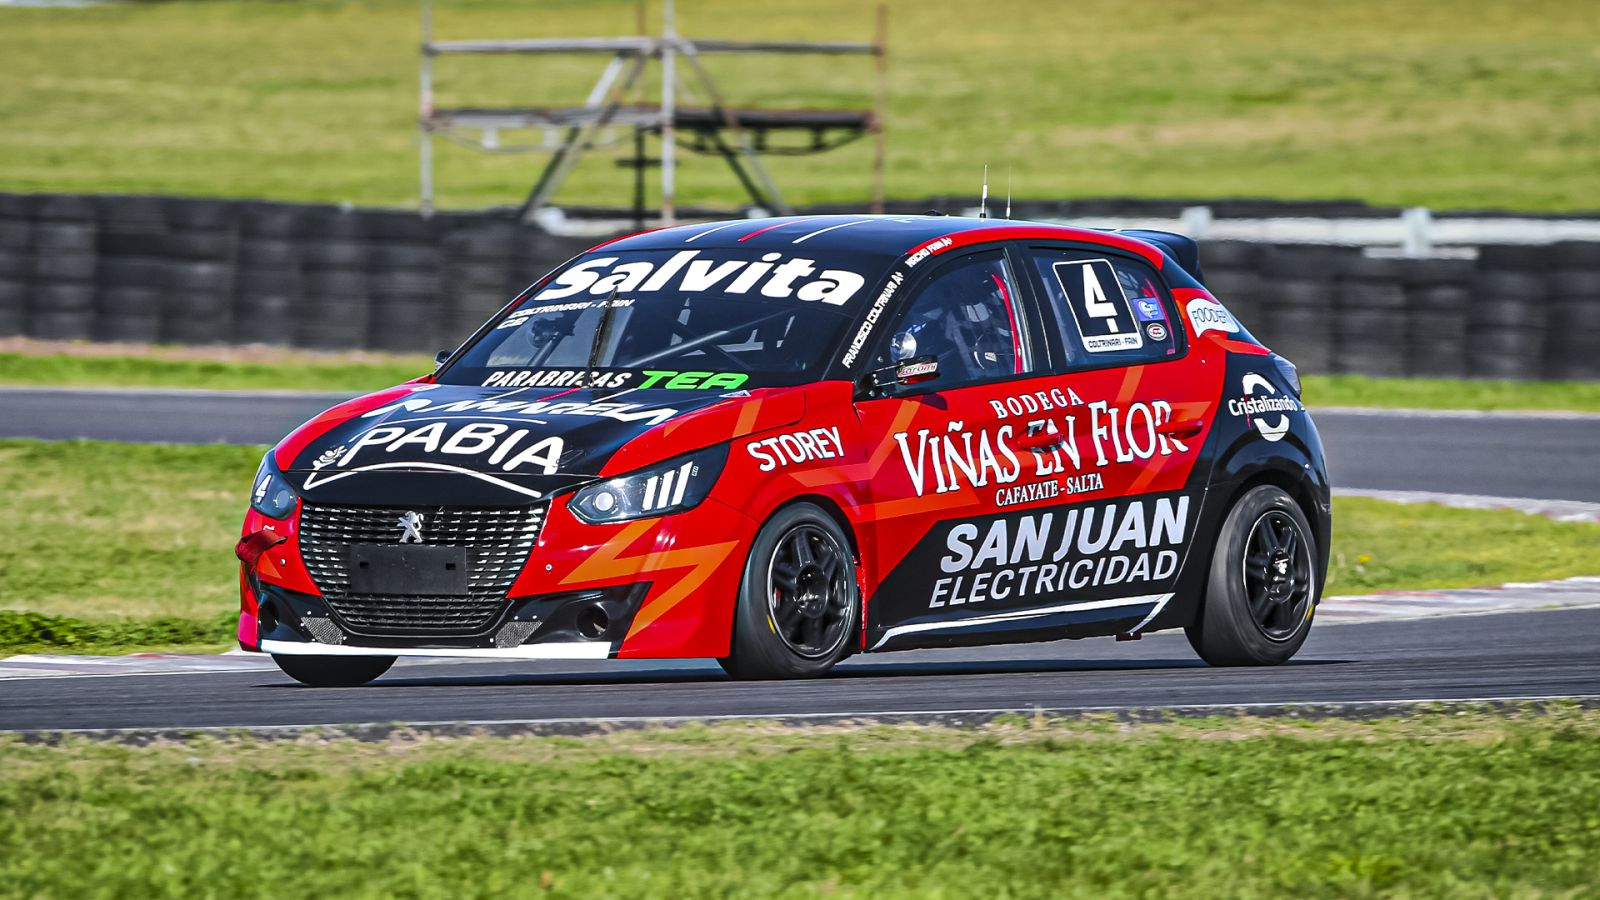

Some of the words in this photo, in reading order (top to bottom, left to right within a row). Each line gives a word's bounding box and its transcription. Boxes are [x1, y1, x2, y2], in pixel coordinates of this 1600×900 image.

[535, 250, 864, 306] Salvita
[1082, 264, 1118, 333] 4
[508, 302, 592, 318] COLTRINARI
[842, 320, 873, 369] FRANCISCO
[866, 280, 898, 325] COLTRINARI
[1088, 337, 1121, 348] COLTRINARI
[641, 370, 749, 390] TEA
[989, 387, 1084, 419] BODEGA
[1228, 394, 1298, 416] Cristalizando
[337, 422, 564, 475] PABIA
[747, 426, 844, 471] STOREY
[894, 420, 1021, 497] VIÑAS
[1028, 415, 1081, 476] EN
[1088, 400, 1189, 467] FLOR
[995, 478, 1059, 507] CAFAYATE
[1066, 472, 1104, 495] SALTA
[940, 513, 1053, 573] SAN
[1052, 496, 1190, 562] JUAN
[929, 550, 1178, 608] ELECTRICIDAD
